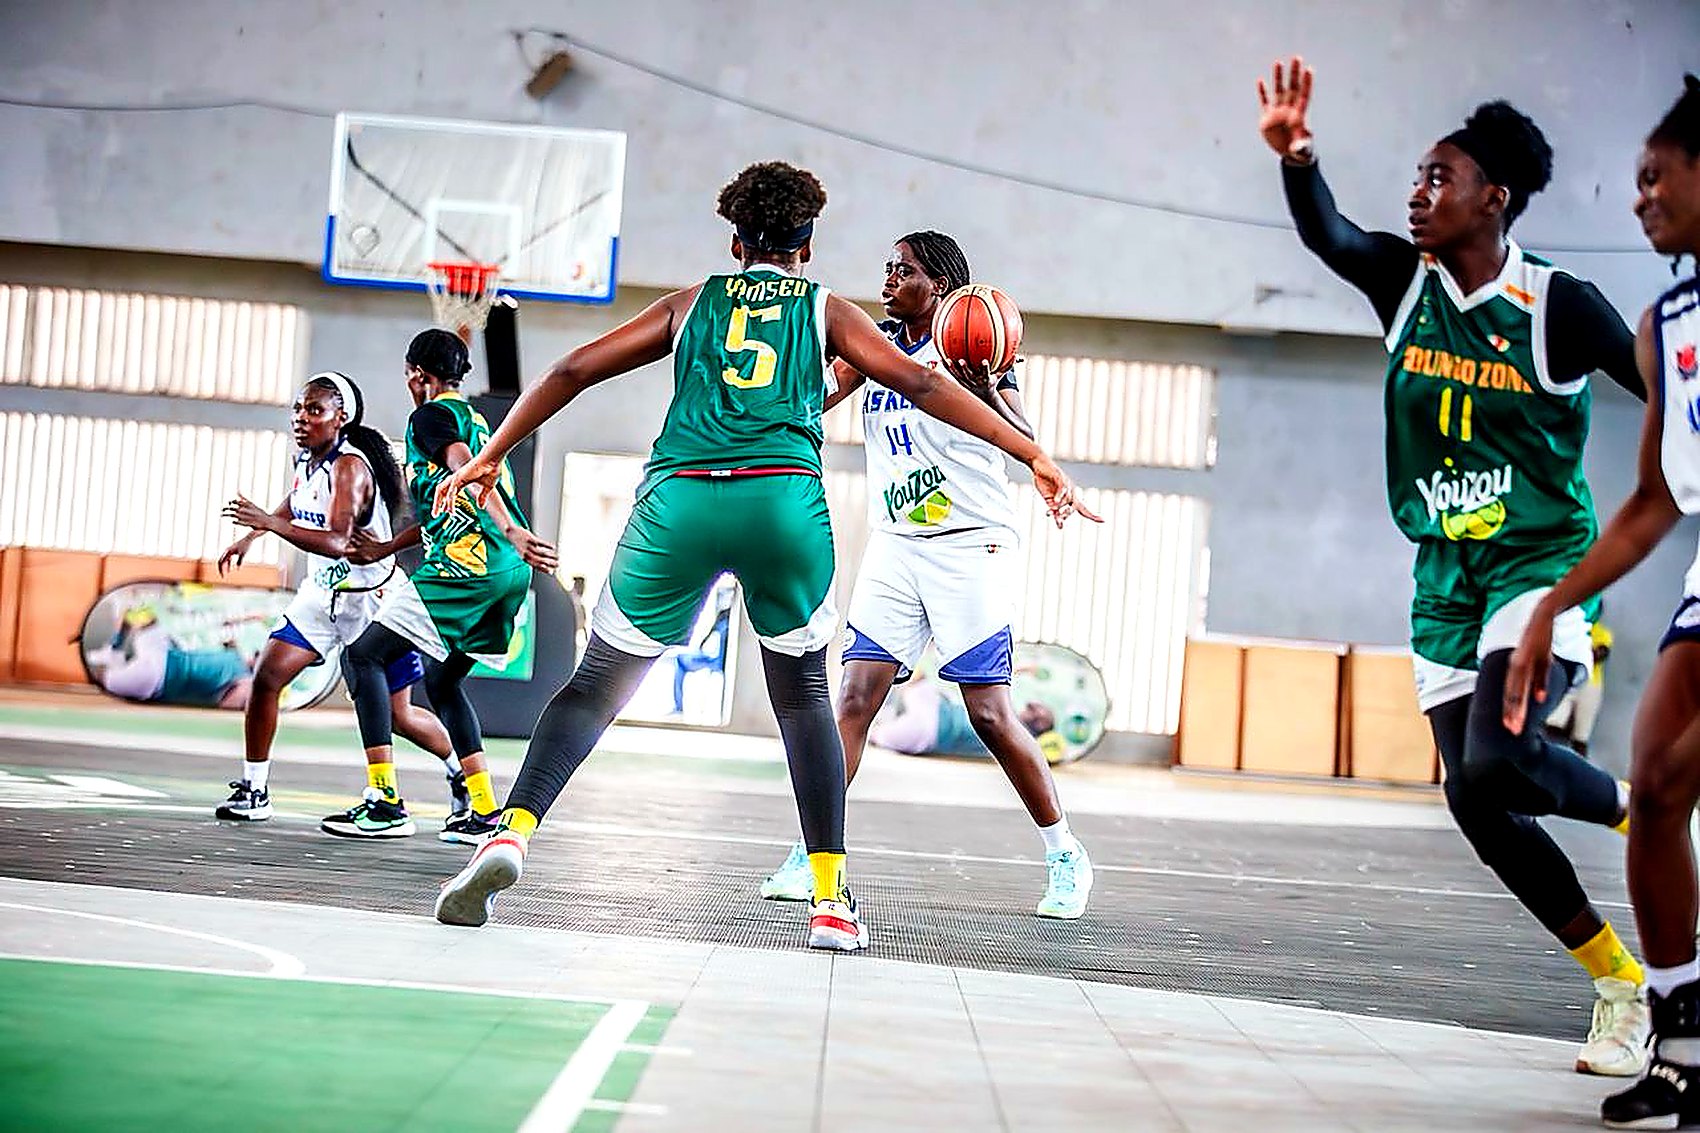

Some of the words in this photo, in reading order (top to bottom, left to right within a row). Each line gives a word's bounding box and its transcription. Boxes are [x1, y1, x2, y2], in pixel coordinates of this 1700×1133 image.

[722, 303, 783, 389] 5
[885, 423, 913, 456] 14
[1438, 387, 1473, 442] 11
